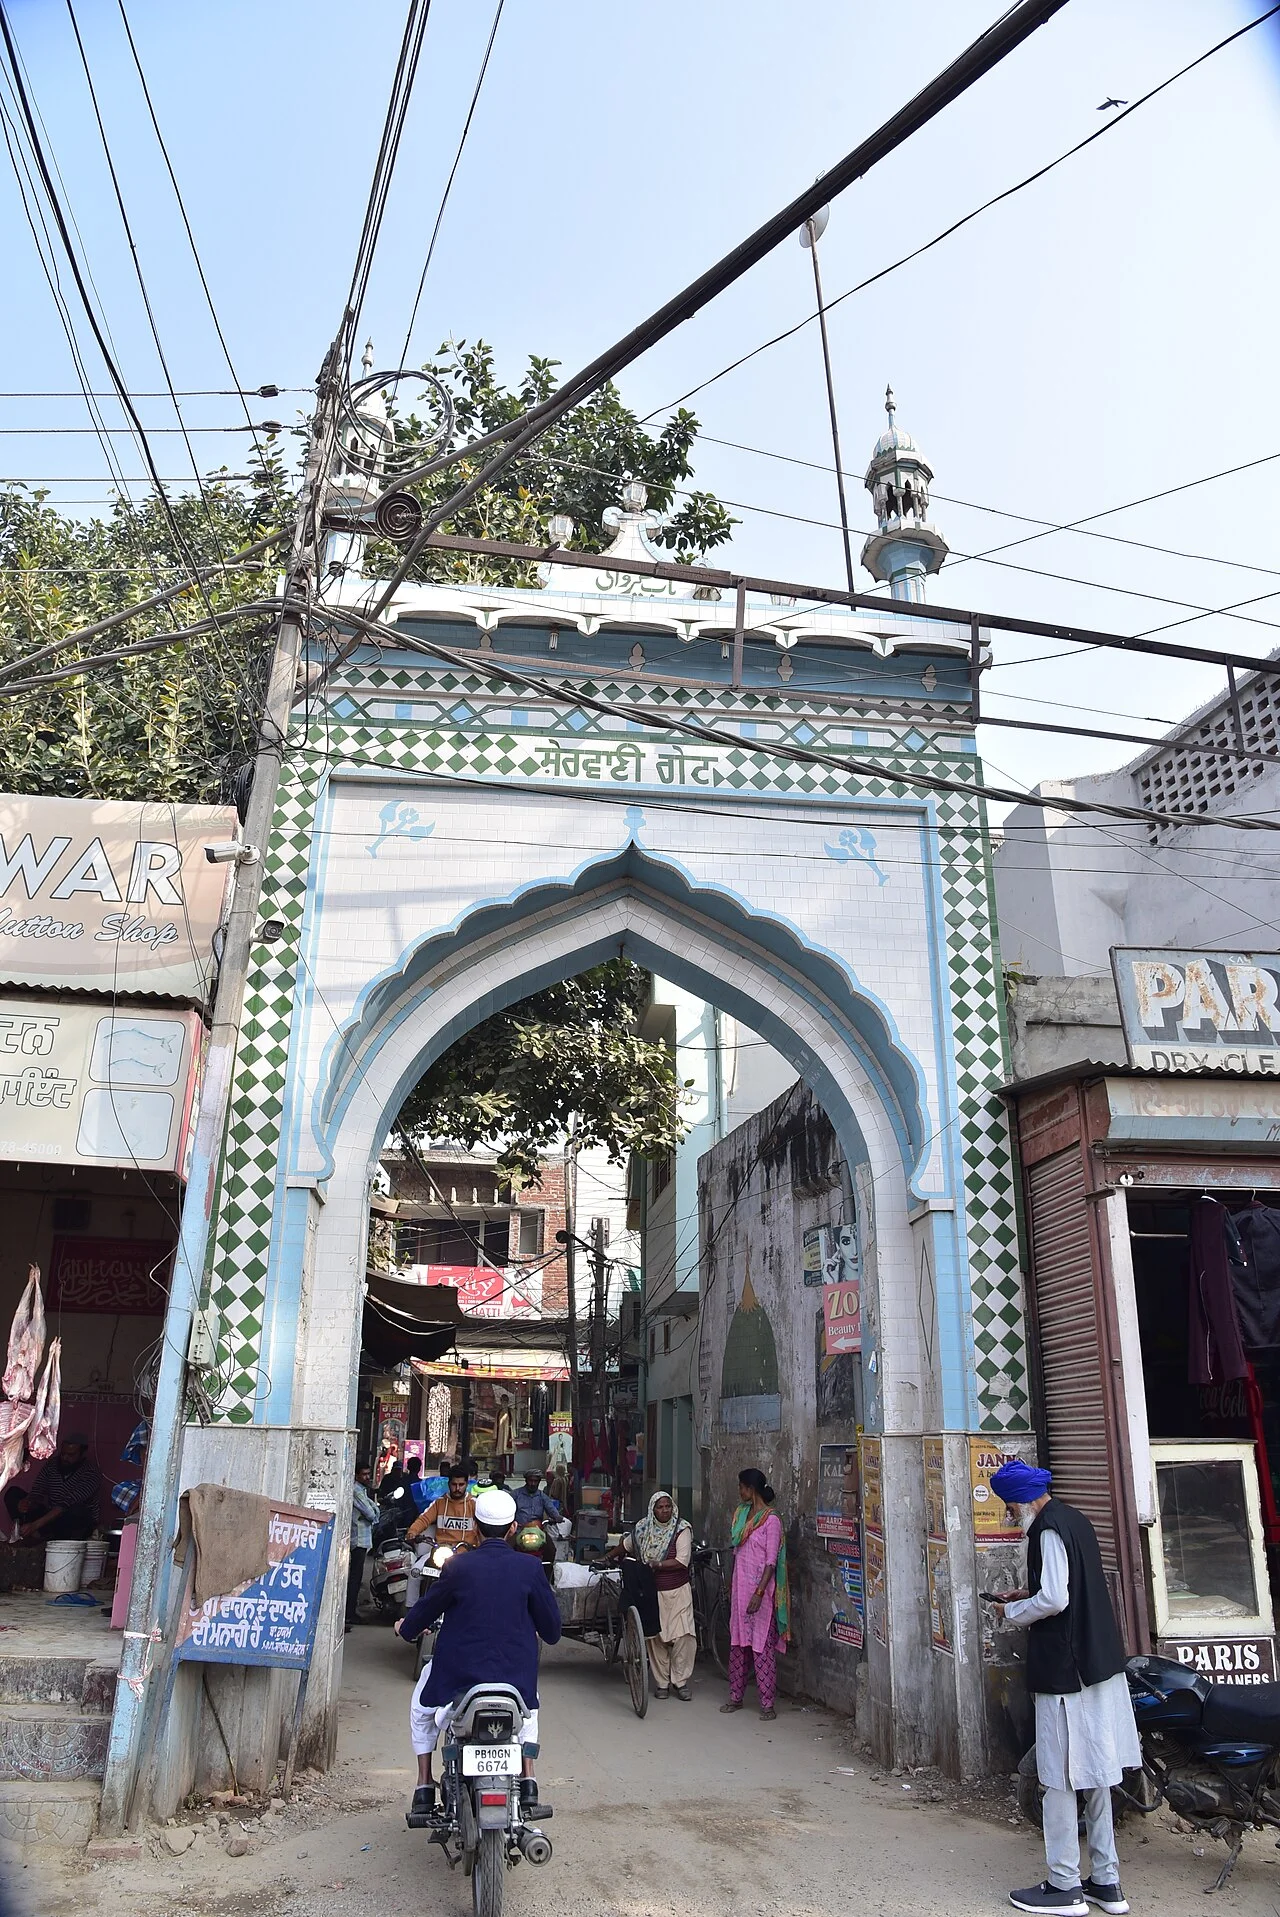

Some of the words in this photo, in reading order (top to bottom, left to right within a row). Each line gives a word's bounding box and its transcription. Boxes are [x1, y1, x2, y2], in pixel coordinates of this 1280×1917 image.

[656, 744, 719, 785] ਗੇਟ
[94, 912, 179, 951] Shop
[827, 1290, 860, 1321] ZO
[828, 1323, 856, 1336] Beauty
[443, 1517, 469, 1530] VANS
[1176, 1644, 1260, 1671] PARIS
[475, 1749, 511, 1759] PB10GN
[477, 1760, 508, 1772] 6674
